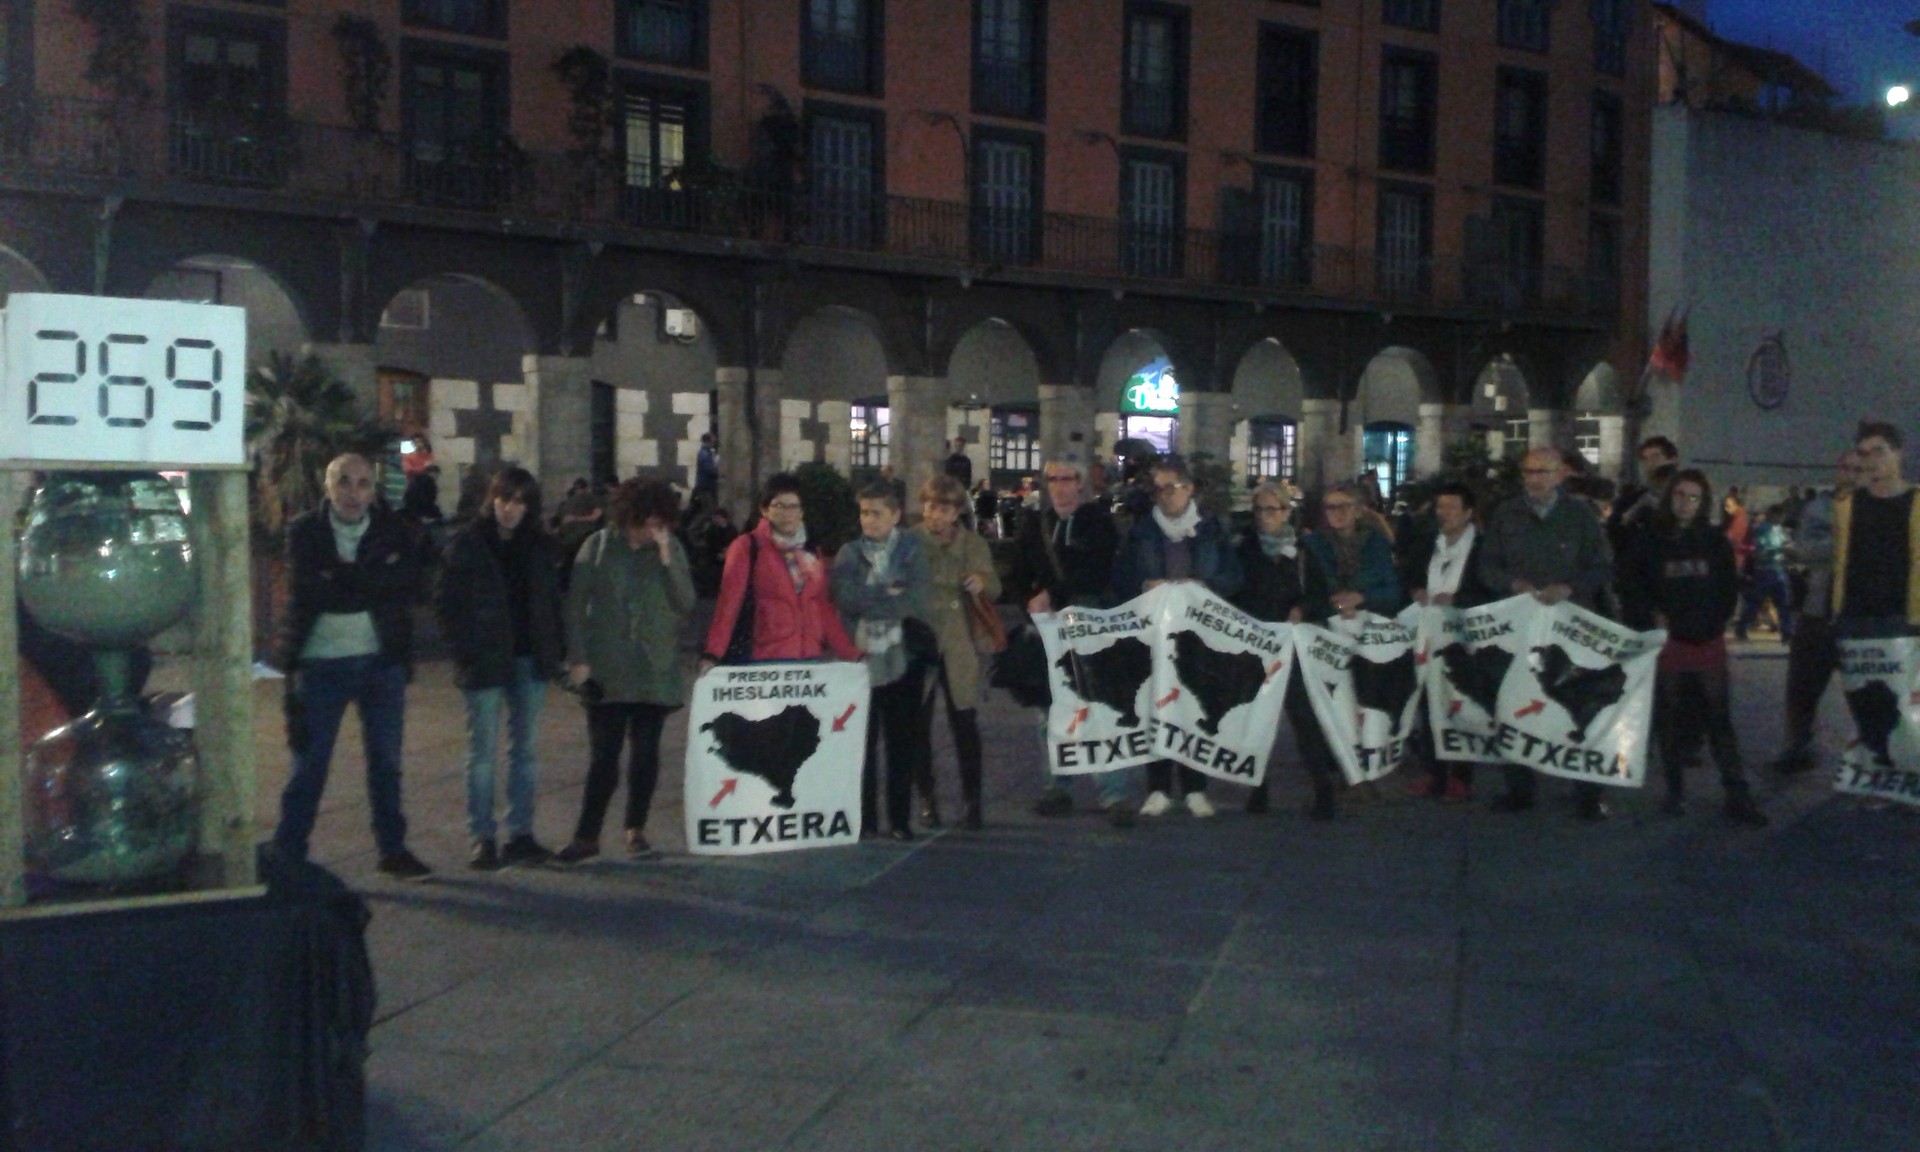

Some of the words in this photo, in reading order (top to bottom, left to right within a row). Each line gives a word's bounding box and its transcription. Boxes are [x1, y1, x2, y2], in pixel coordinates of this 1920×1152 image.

[28, 330, 222, 431] 269
[1203, 599, 1248, 625] PRESO
[728, 671, 779, 683] PRESO
[784, 670, 812, 680] ETA
[712, 683, 827, 702] IHESLARIAK
[1150, 717, 1256, 778] ETXERA
[698, 810, 851, 846] ETXERA
